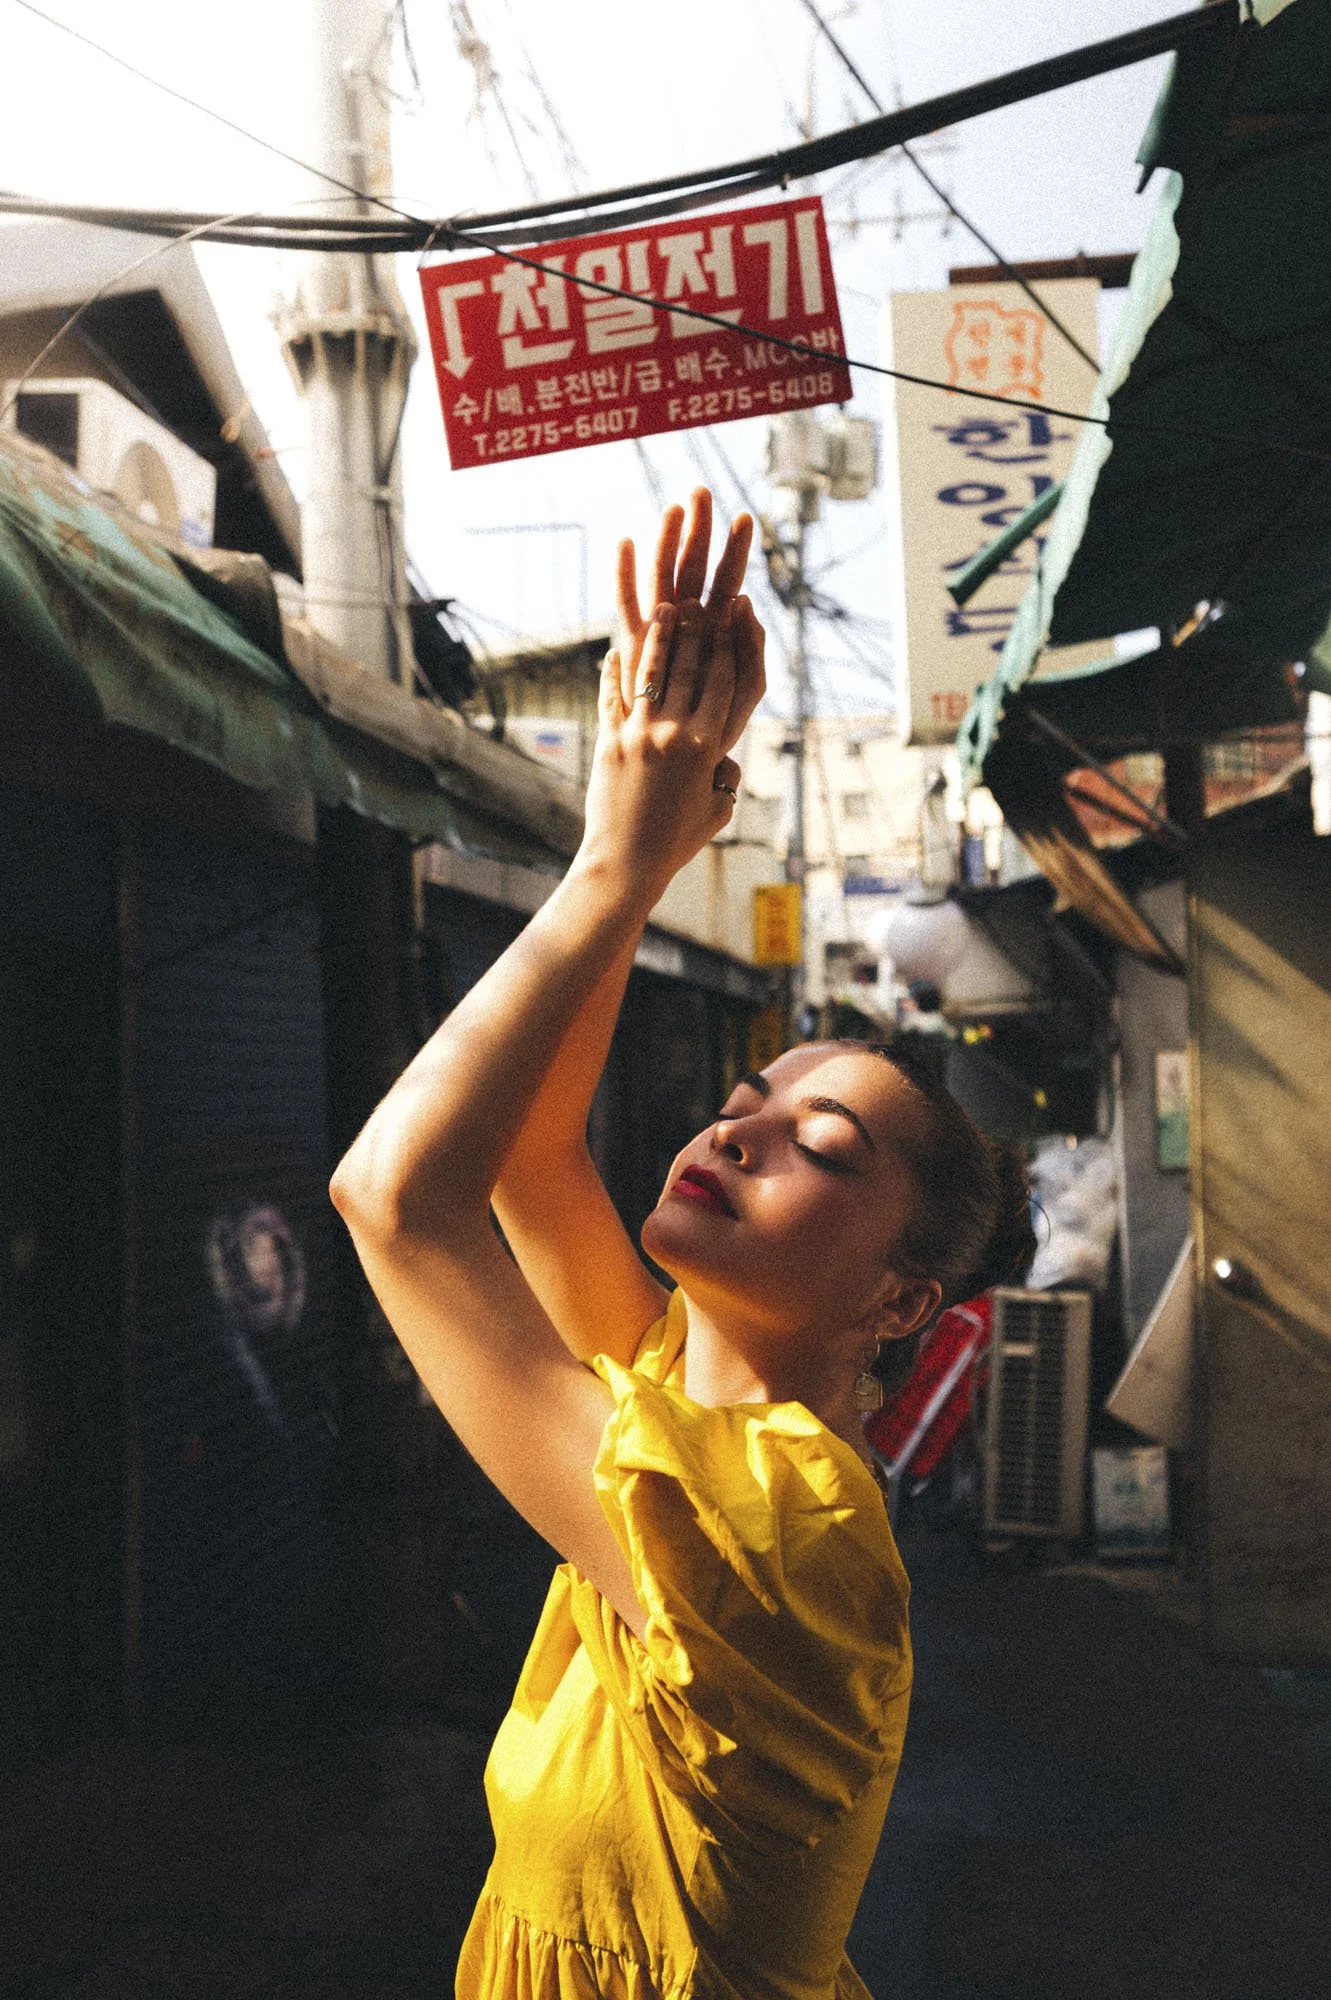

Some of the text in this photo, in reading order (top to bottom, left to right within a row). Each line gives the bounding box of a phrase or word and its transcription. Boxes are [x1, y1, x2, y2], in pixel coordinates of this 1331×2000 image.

[491, 210, 825, 369] 천일전기
[472, 372, 833, 457] T.2275-6407 F.2275-6408
